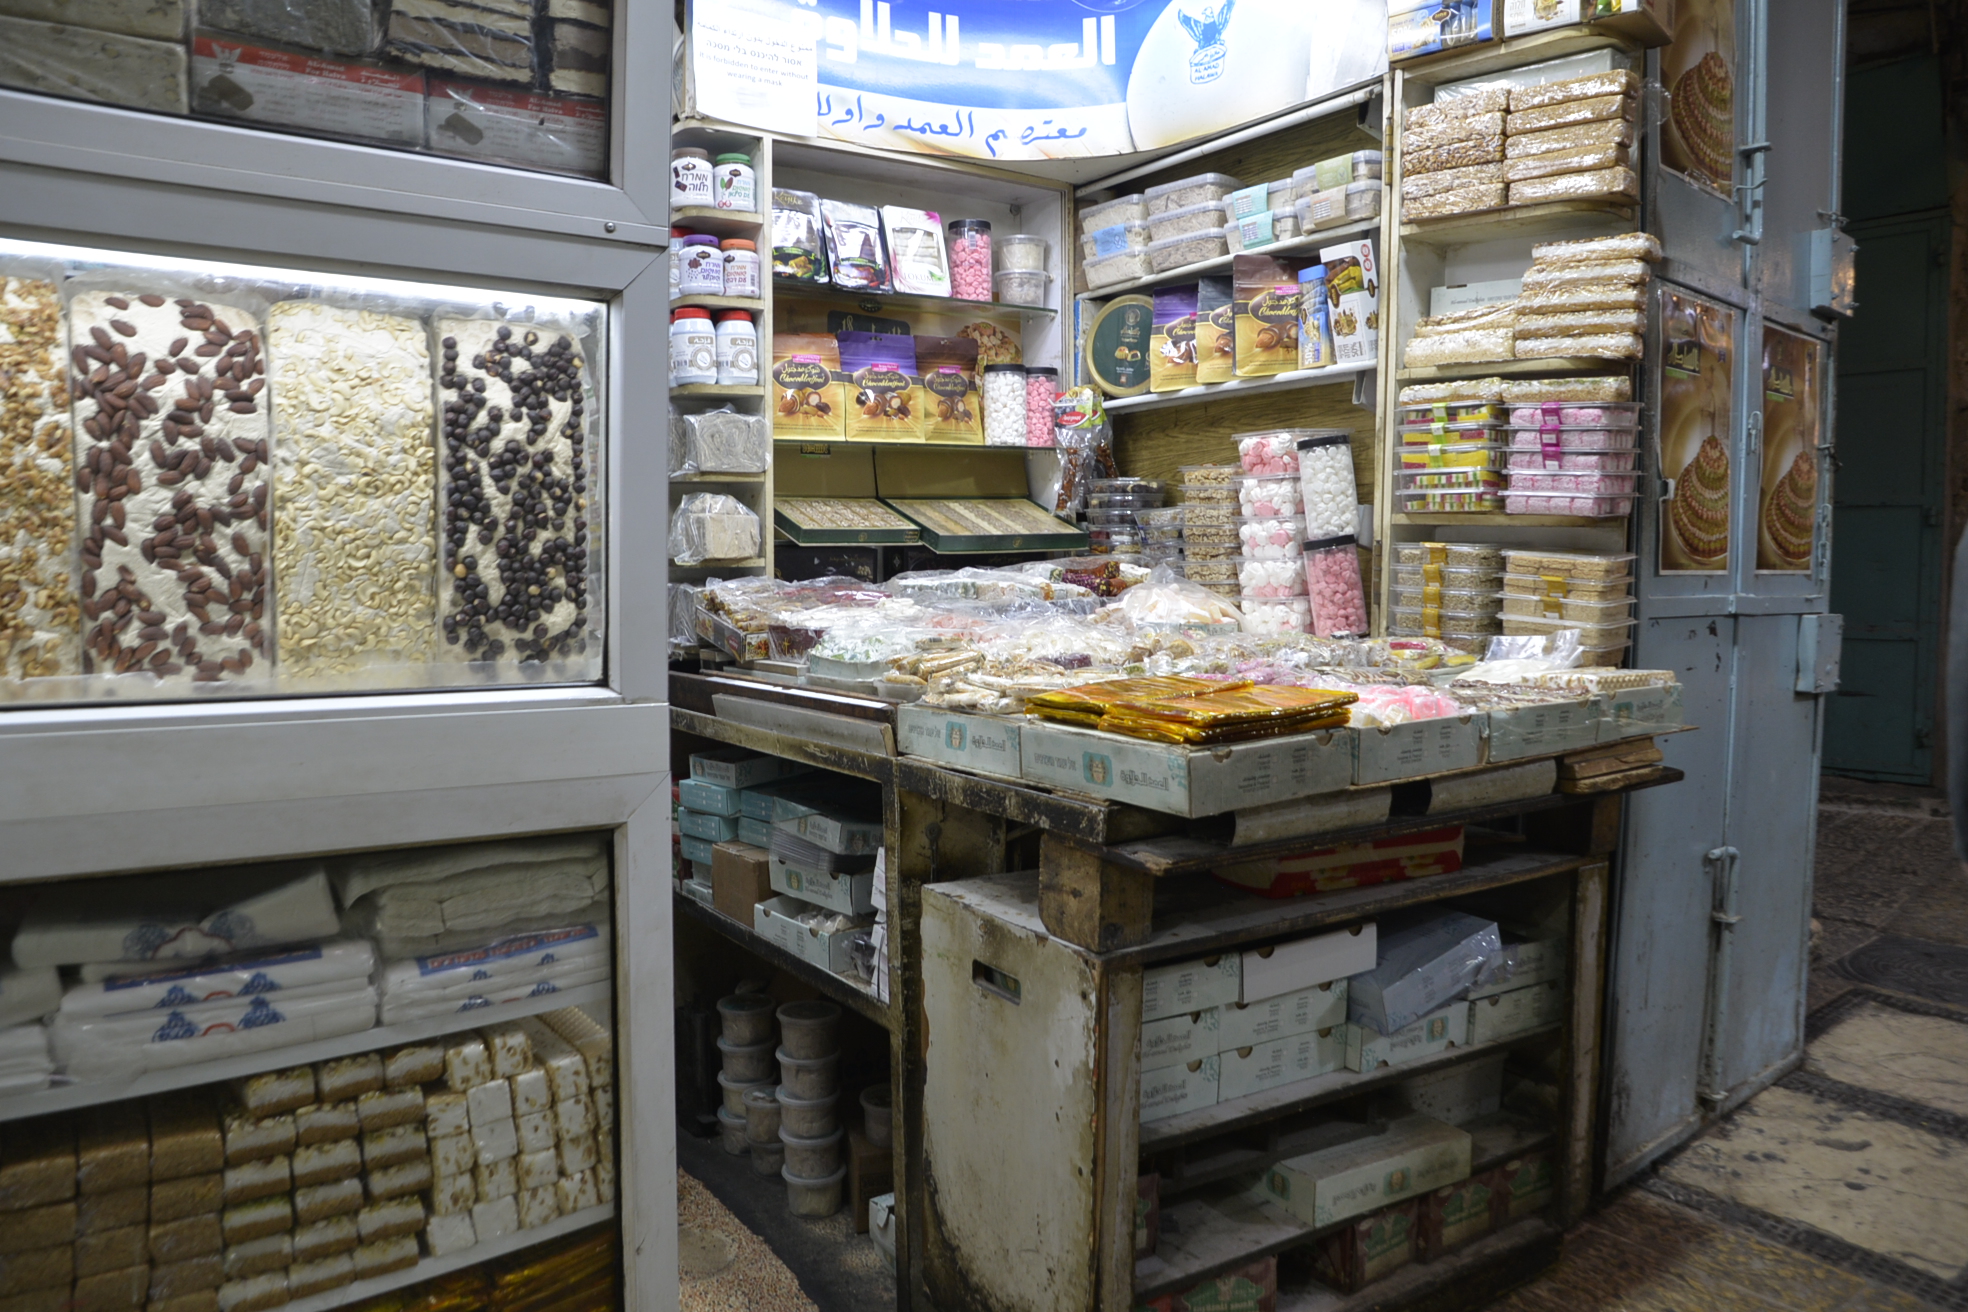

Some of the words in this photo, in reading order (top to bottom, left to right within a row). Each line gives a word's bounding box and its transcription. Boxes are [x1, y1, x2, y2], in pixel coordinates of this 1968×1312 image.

[706, 39, 730, 51] מסכה
[975, 14, 1117, 71] العمد
[733, 45, 747, 55] בלי
[750, 50, 779, 62] להיכנס
[713, 55, 749, 69] forbidden
[760, 66, 779, 75] enter
[780, 69, 809, 80] without
[782, 56, 802, 66] אסור
[727, 71, 756, 83] wearing
[764, 78, 783, 87] mask
[893, 110, 975, 138] العمد
[681, 172, 708, 181] ממרח
[1305, 342, 1313, 365] 50%
